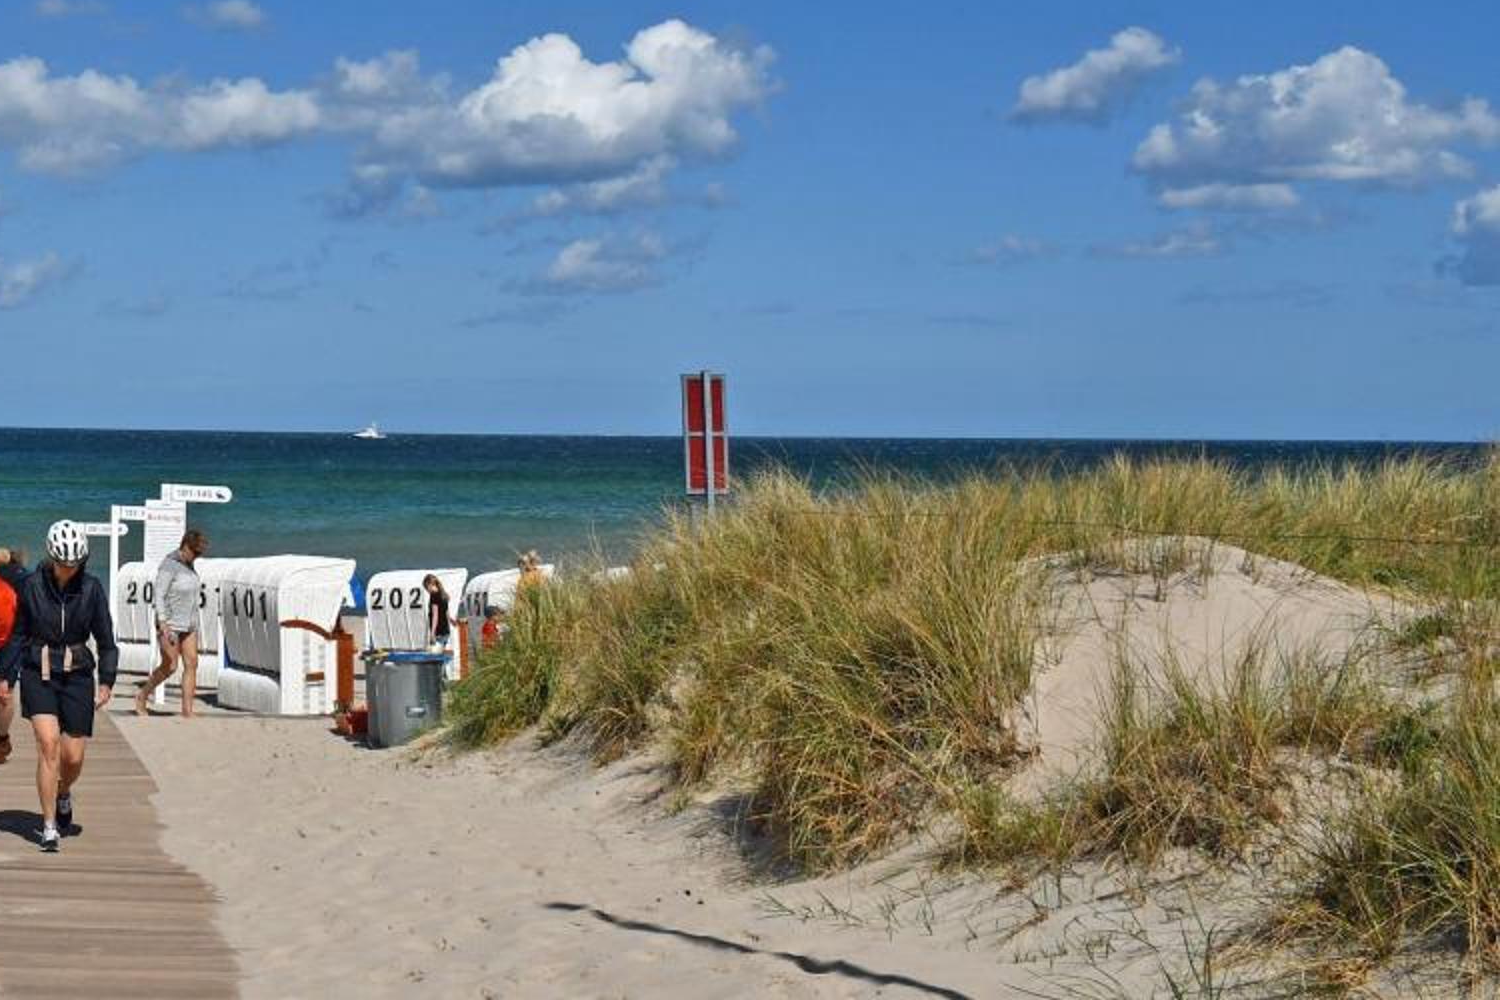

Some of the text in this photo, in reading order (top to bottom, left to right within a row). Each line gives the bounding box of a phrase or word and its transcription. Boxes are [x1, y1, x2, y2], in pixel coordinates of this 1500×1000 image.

[126, 581, 154, 604] 20
[230, 586, 267, 621] 101
[371, 587, 422, 610] 202
